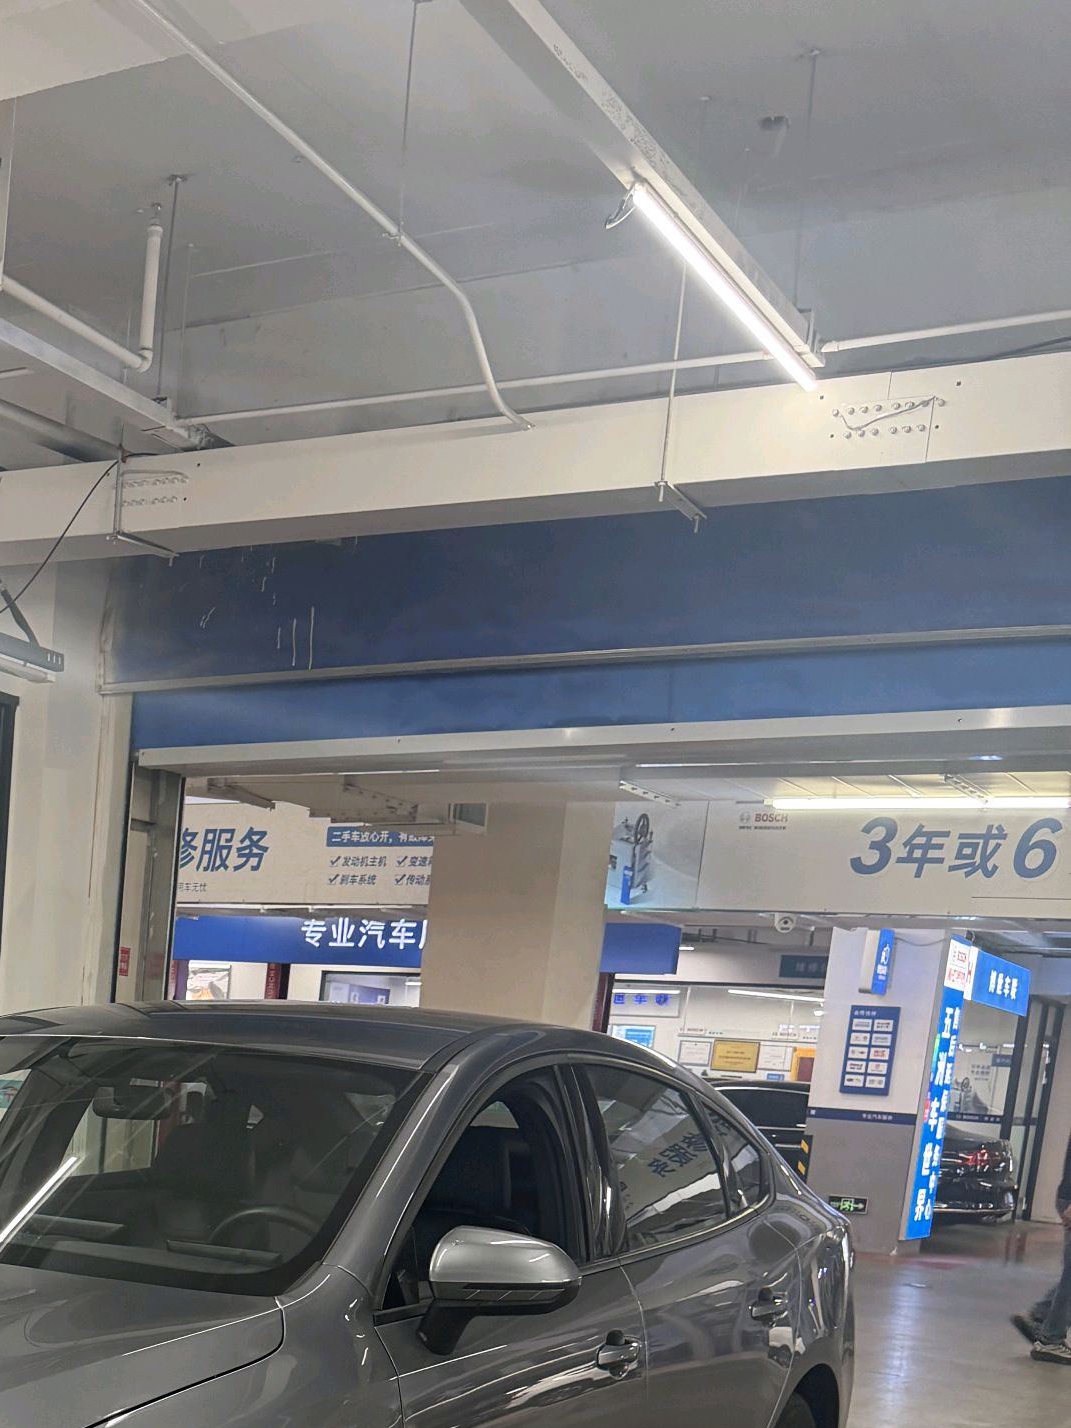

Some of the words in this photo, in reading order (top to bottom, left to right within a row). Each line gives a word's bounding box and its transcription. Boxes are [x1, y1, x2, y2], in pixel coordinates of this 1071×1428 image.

[754, 813, 788, 822] BOSCH
[301, 917, 428, 950] 专业汽车
